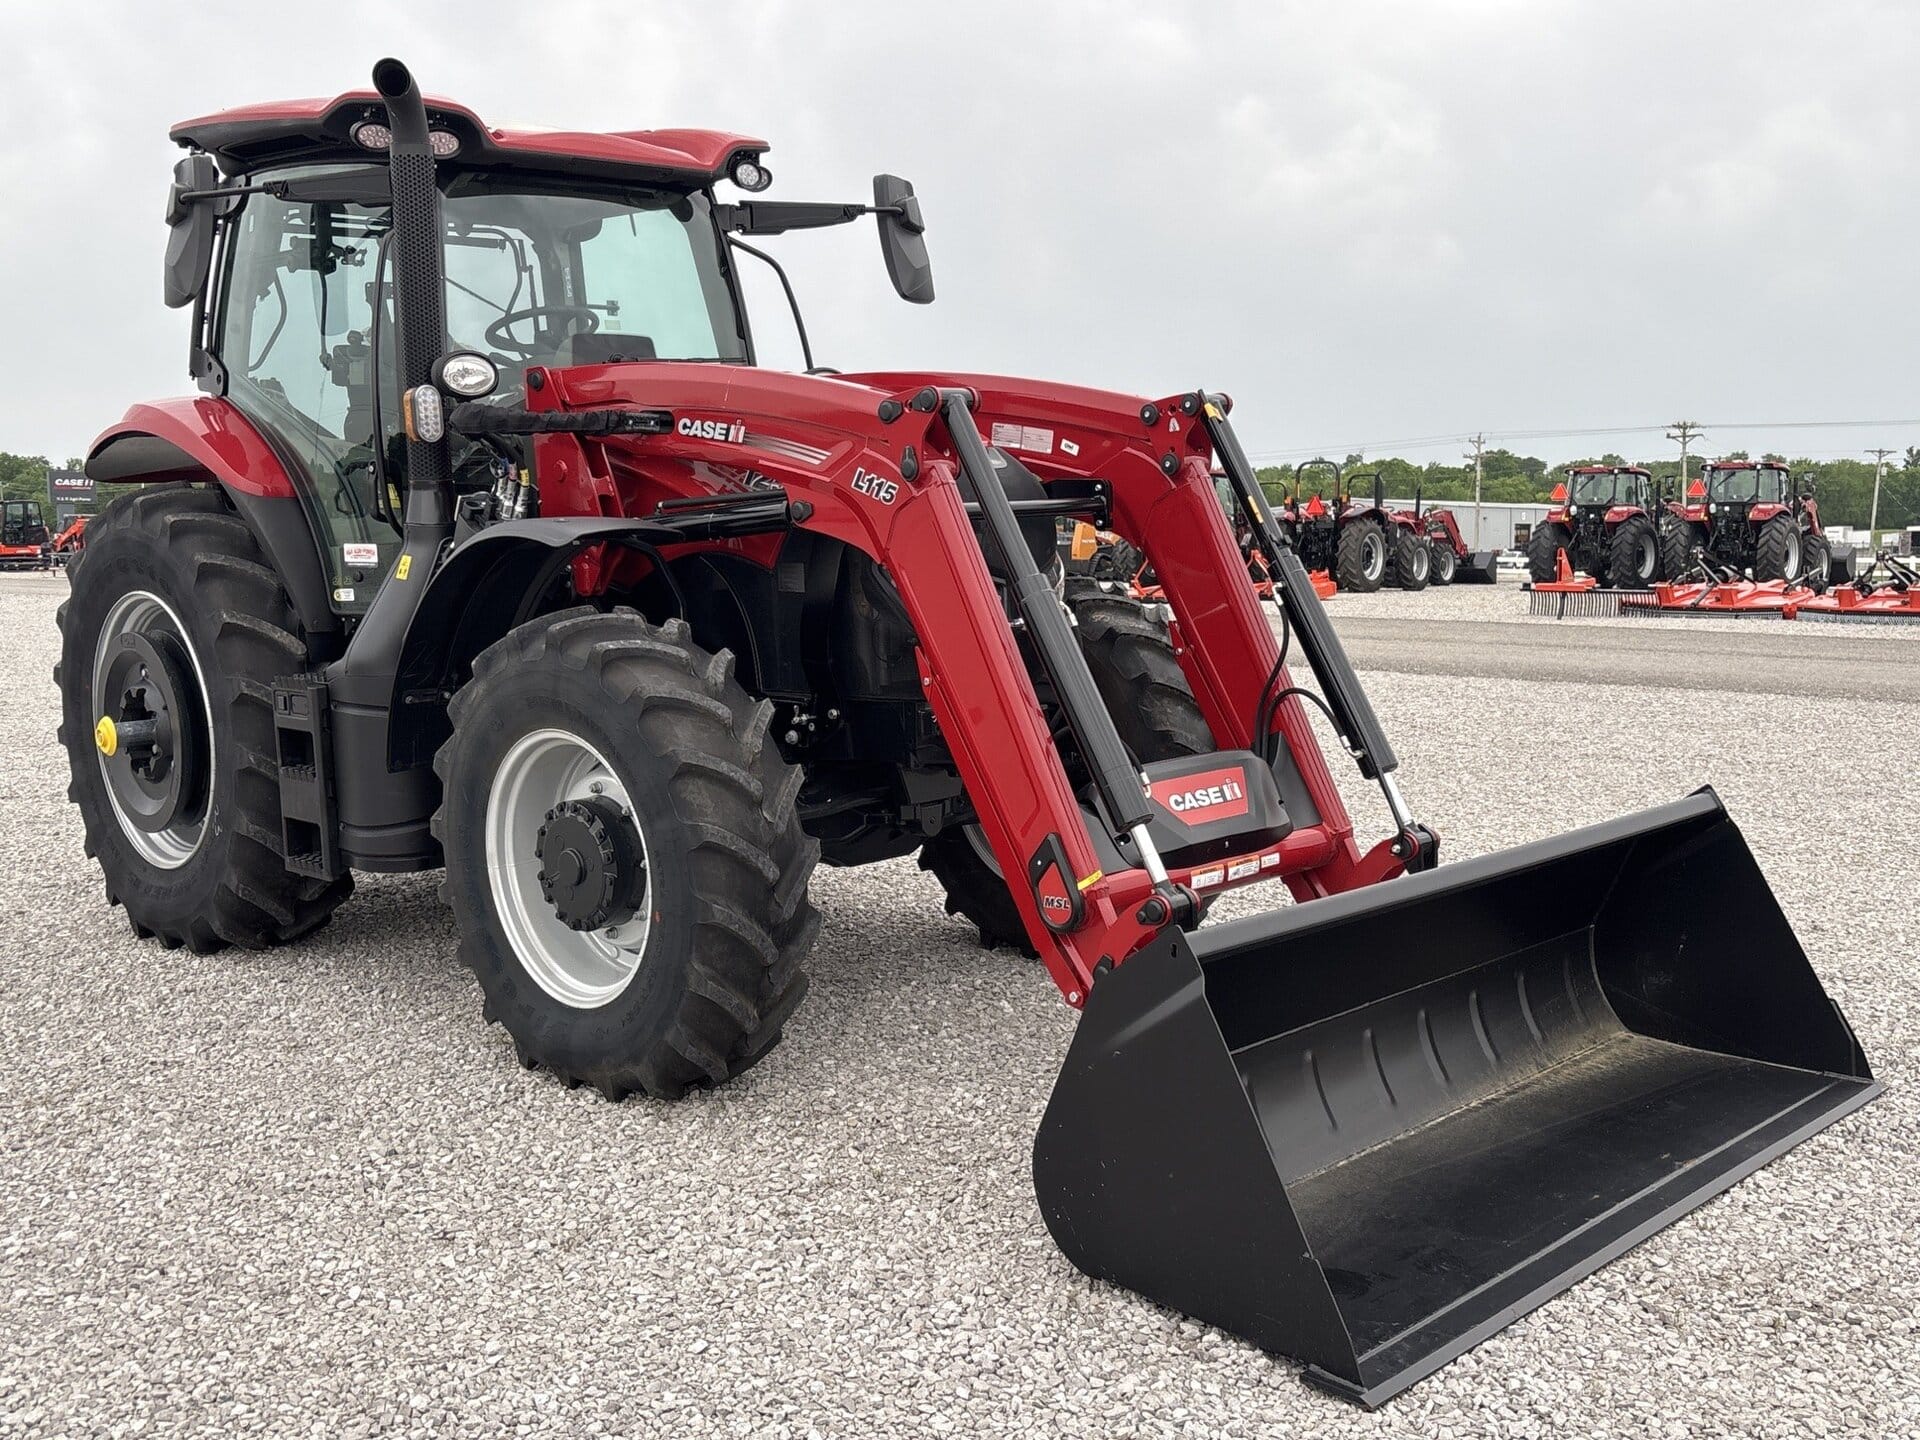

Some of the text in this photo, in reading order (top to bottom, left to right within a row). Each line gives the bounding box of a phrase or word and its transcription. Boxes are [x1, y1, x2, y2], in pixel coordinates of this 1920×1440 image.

[678, 417, 727, 440] CASE
[55, 478, 84, 486] CASE
[851, 467, 899, 505] L115
[1168, 785, 1224, 811] CASE
[1043, 895, 1071, 910] MSL
